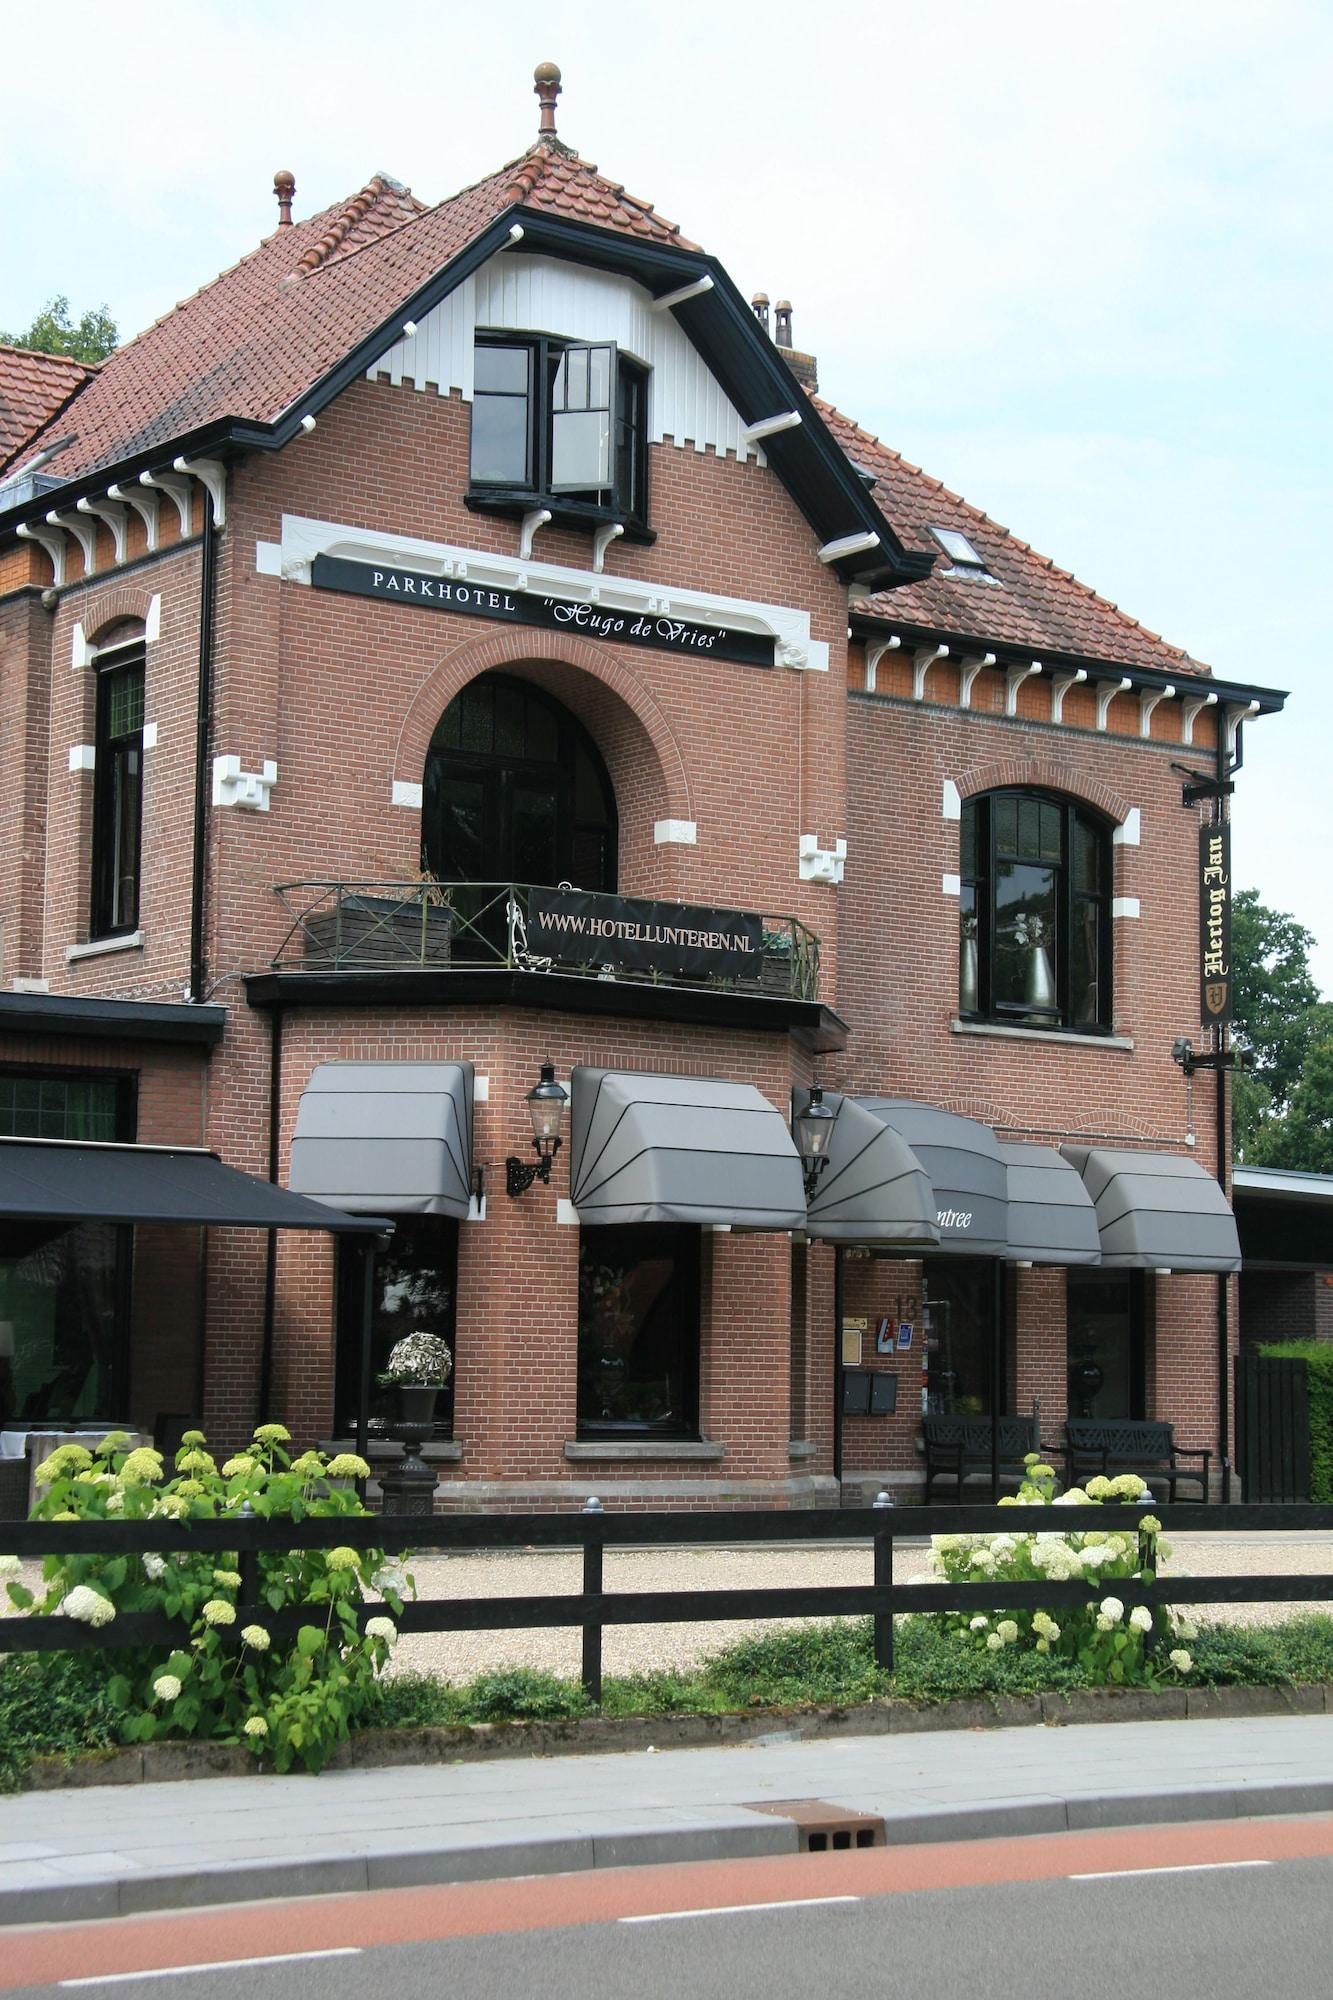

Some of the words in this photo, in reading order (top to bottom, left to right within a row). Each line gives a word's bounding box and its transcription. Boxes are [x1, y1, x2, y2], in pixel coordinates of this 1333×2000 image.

[372, 571, 515, 611] PARKHOTEL
[629, 619, 651, 637] de
[1204, 835, 1229, 885] Jan
[538, 911, 755, 953] WWW.HOTELLUNTEREN.NL
[1204, 888, 1229, 978] Hertog
[936, 1207, 973, 1228] ntree
